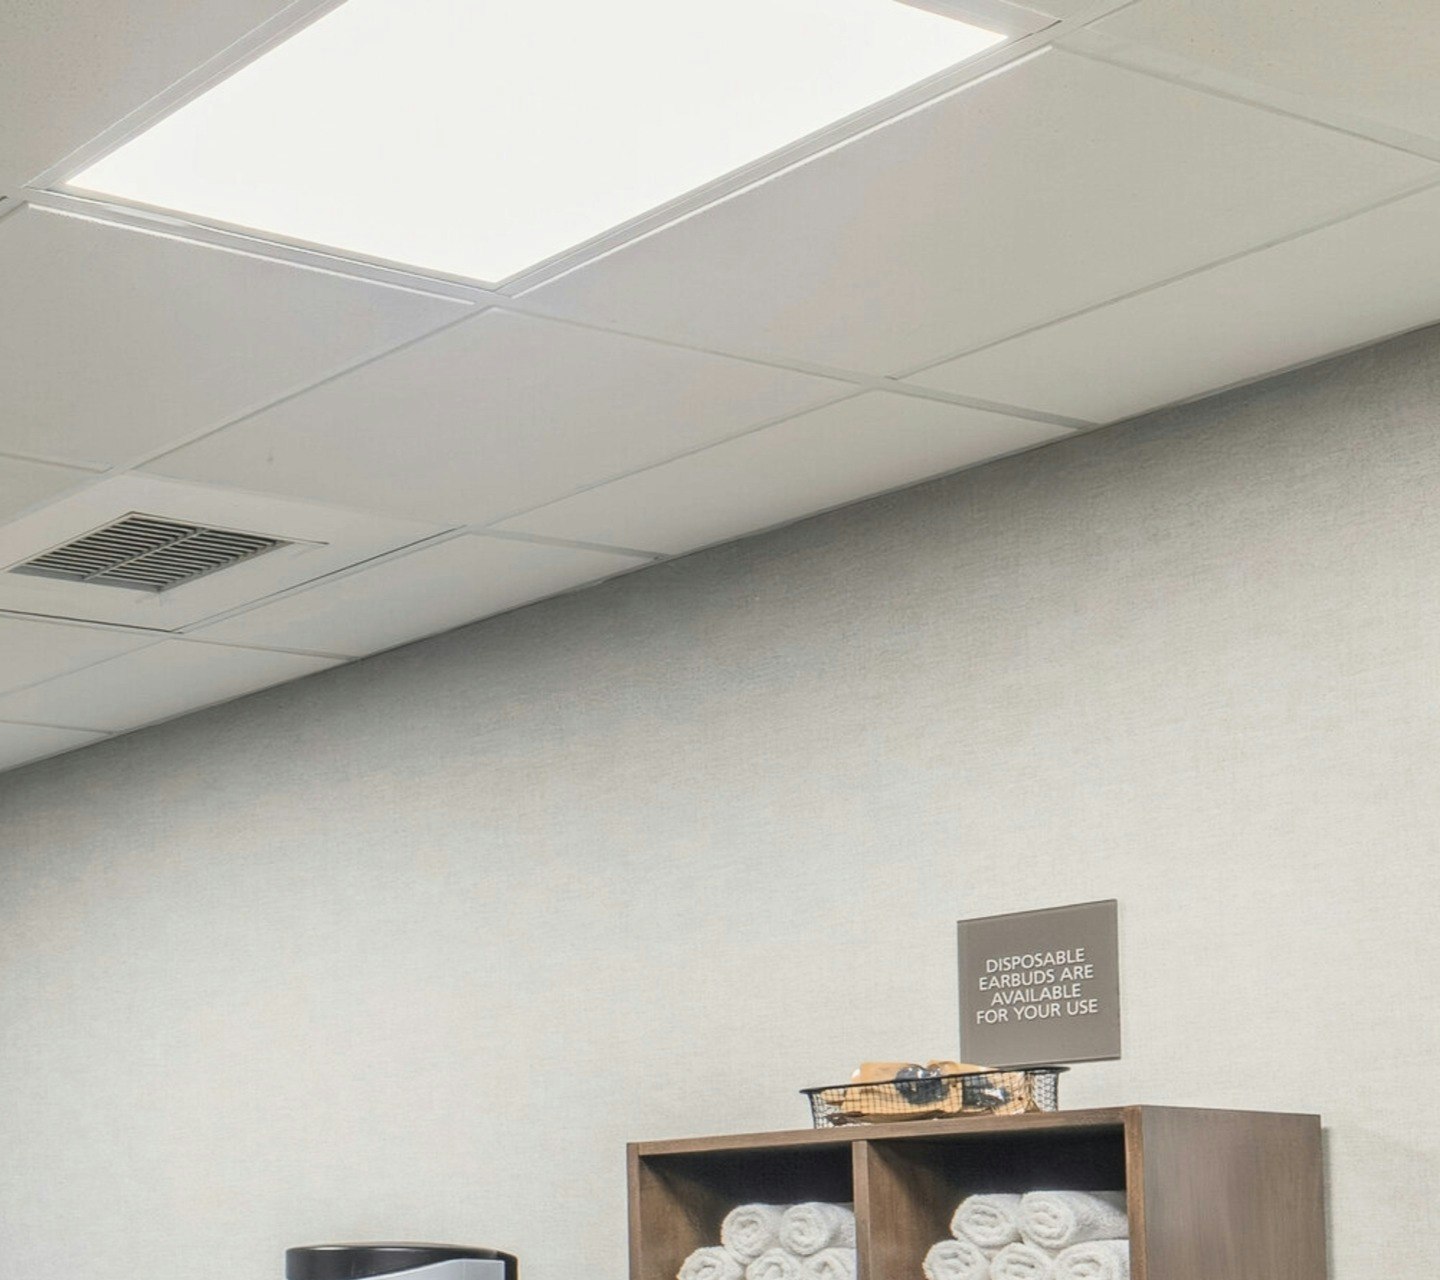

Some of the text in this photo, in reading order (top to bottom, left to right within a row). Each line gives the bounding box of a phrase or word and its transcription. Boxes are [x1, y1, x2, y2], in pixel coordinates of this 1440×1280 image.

[986, 948, 1084, 972] DISPOSABLE
[979, 964, 1093, 990] EARBUDS ARE
[991, 982, 1080, 1005] AVAILABLE
[976, 998, 1097, 1024] FOR YOUR USE
